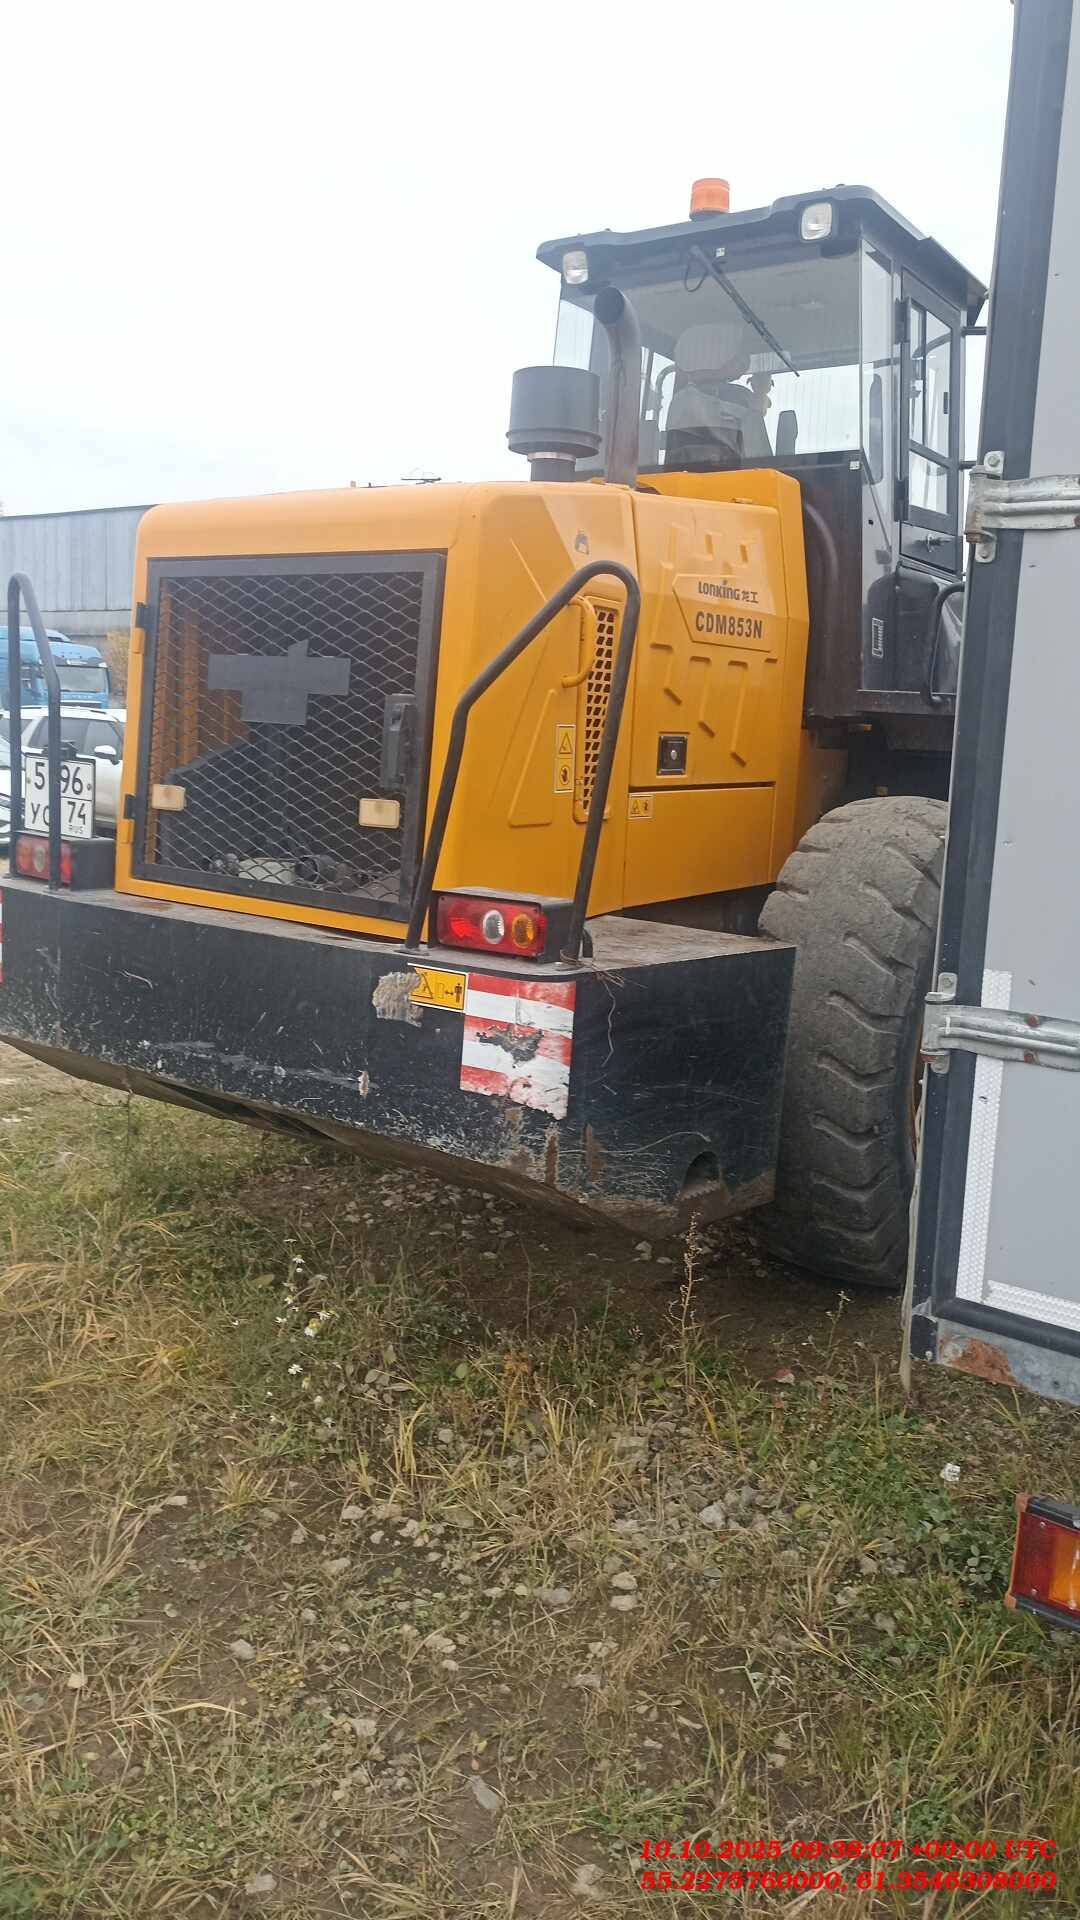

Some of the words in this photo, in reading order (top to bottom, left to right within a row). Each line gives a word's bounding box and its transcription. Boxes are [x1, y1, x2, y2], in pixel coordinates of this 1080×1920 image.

[695, 611, 763, 639] CDM853N
[33, 761, 84, 796] 596
[67, 800, 87, 826] 74
